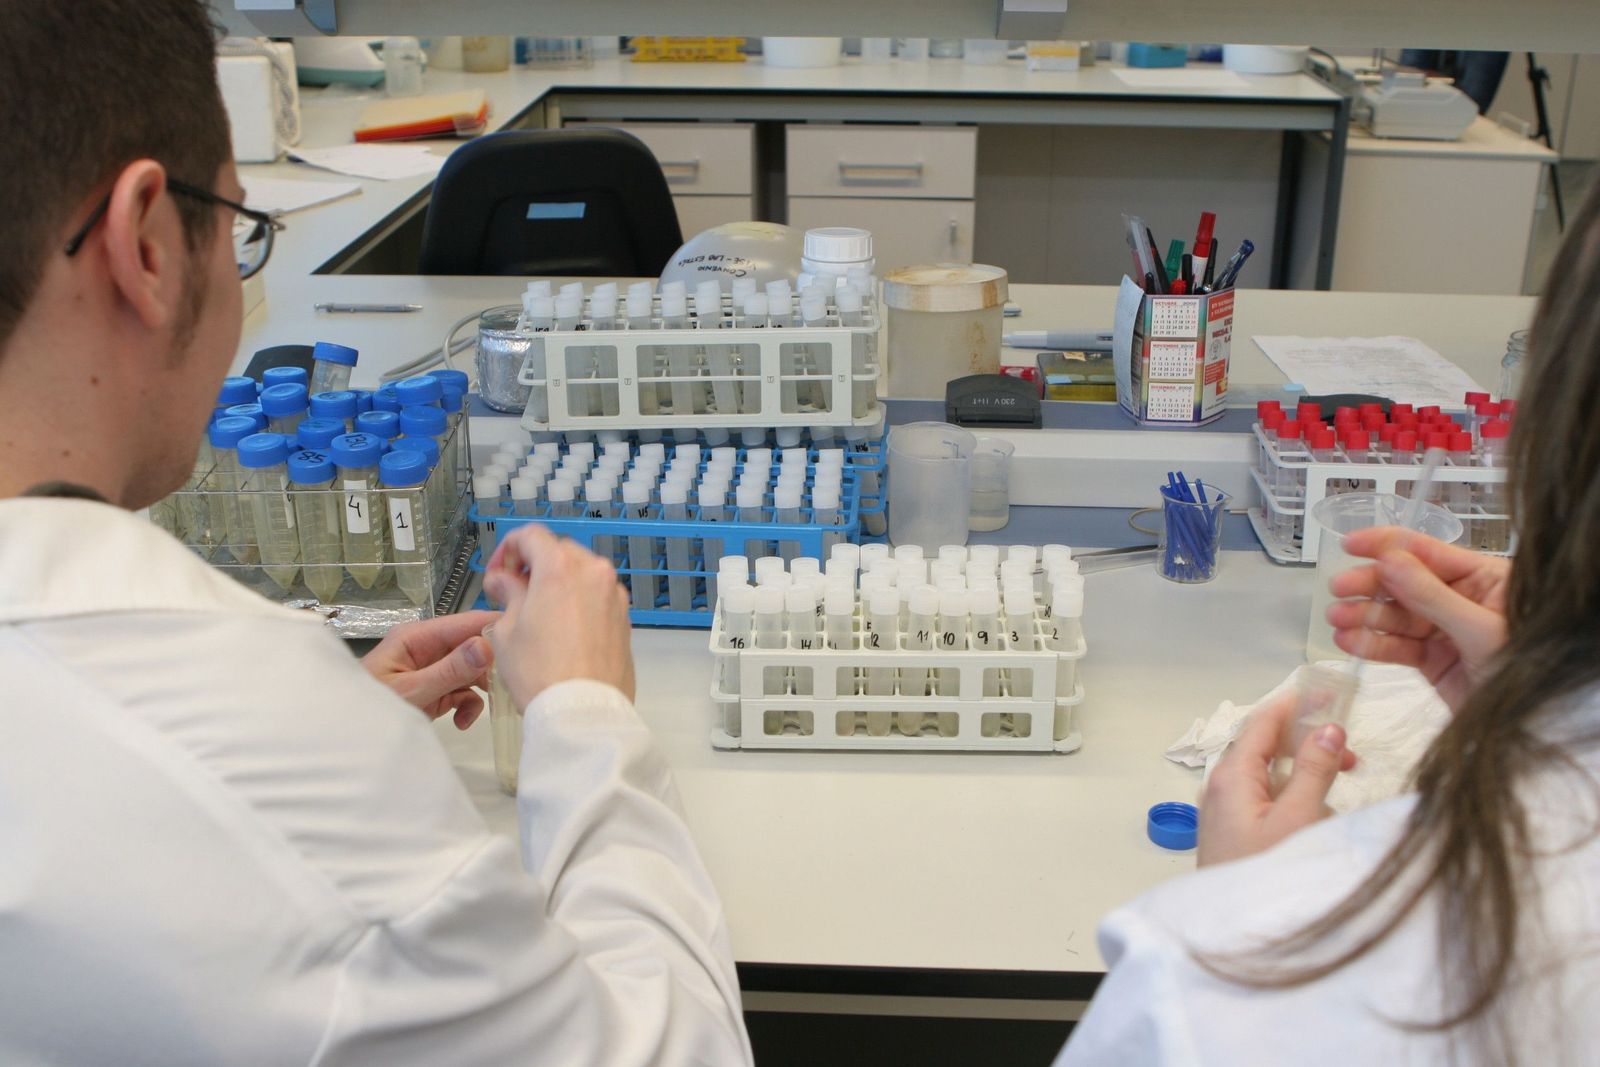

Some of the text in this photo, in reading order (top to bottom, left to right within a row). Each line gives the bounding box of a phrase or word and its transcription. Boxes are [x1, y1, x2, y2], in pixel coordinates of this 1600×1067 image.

[298, 451, 327, 463] 85
[348, 495, 362, 518] 4
[395, 512, 409, 529] 1
[871, 632, 880, 648] 12
[917, 630, 929, 643] 11
[943, 632, 955, 645] 10
[978, 631, 988, 644] 9
[1012, 631, 1019, 642] 3
[1053, 628, 1058, 640] 2
[730, 636, 745, 649] 16
[801, 639, 812, 650] 14
